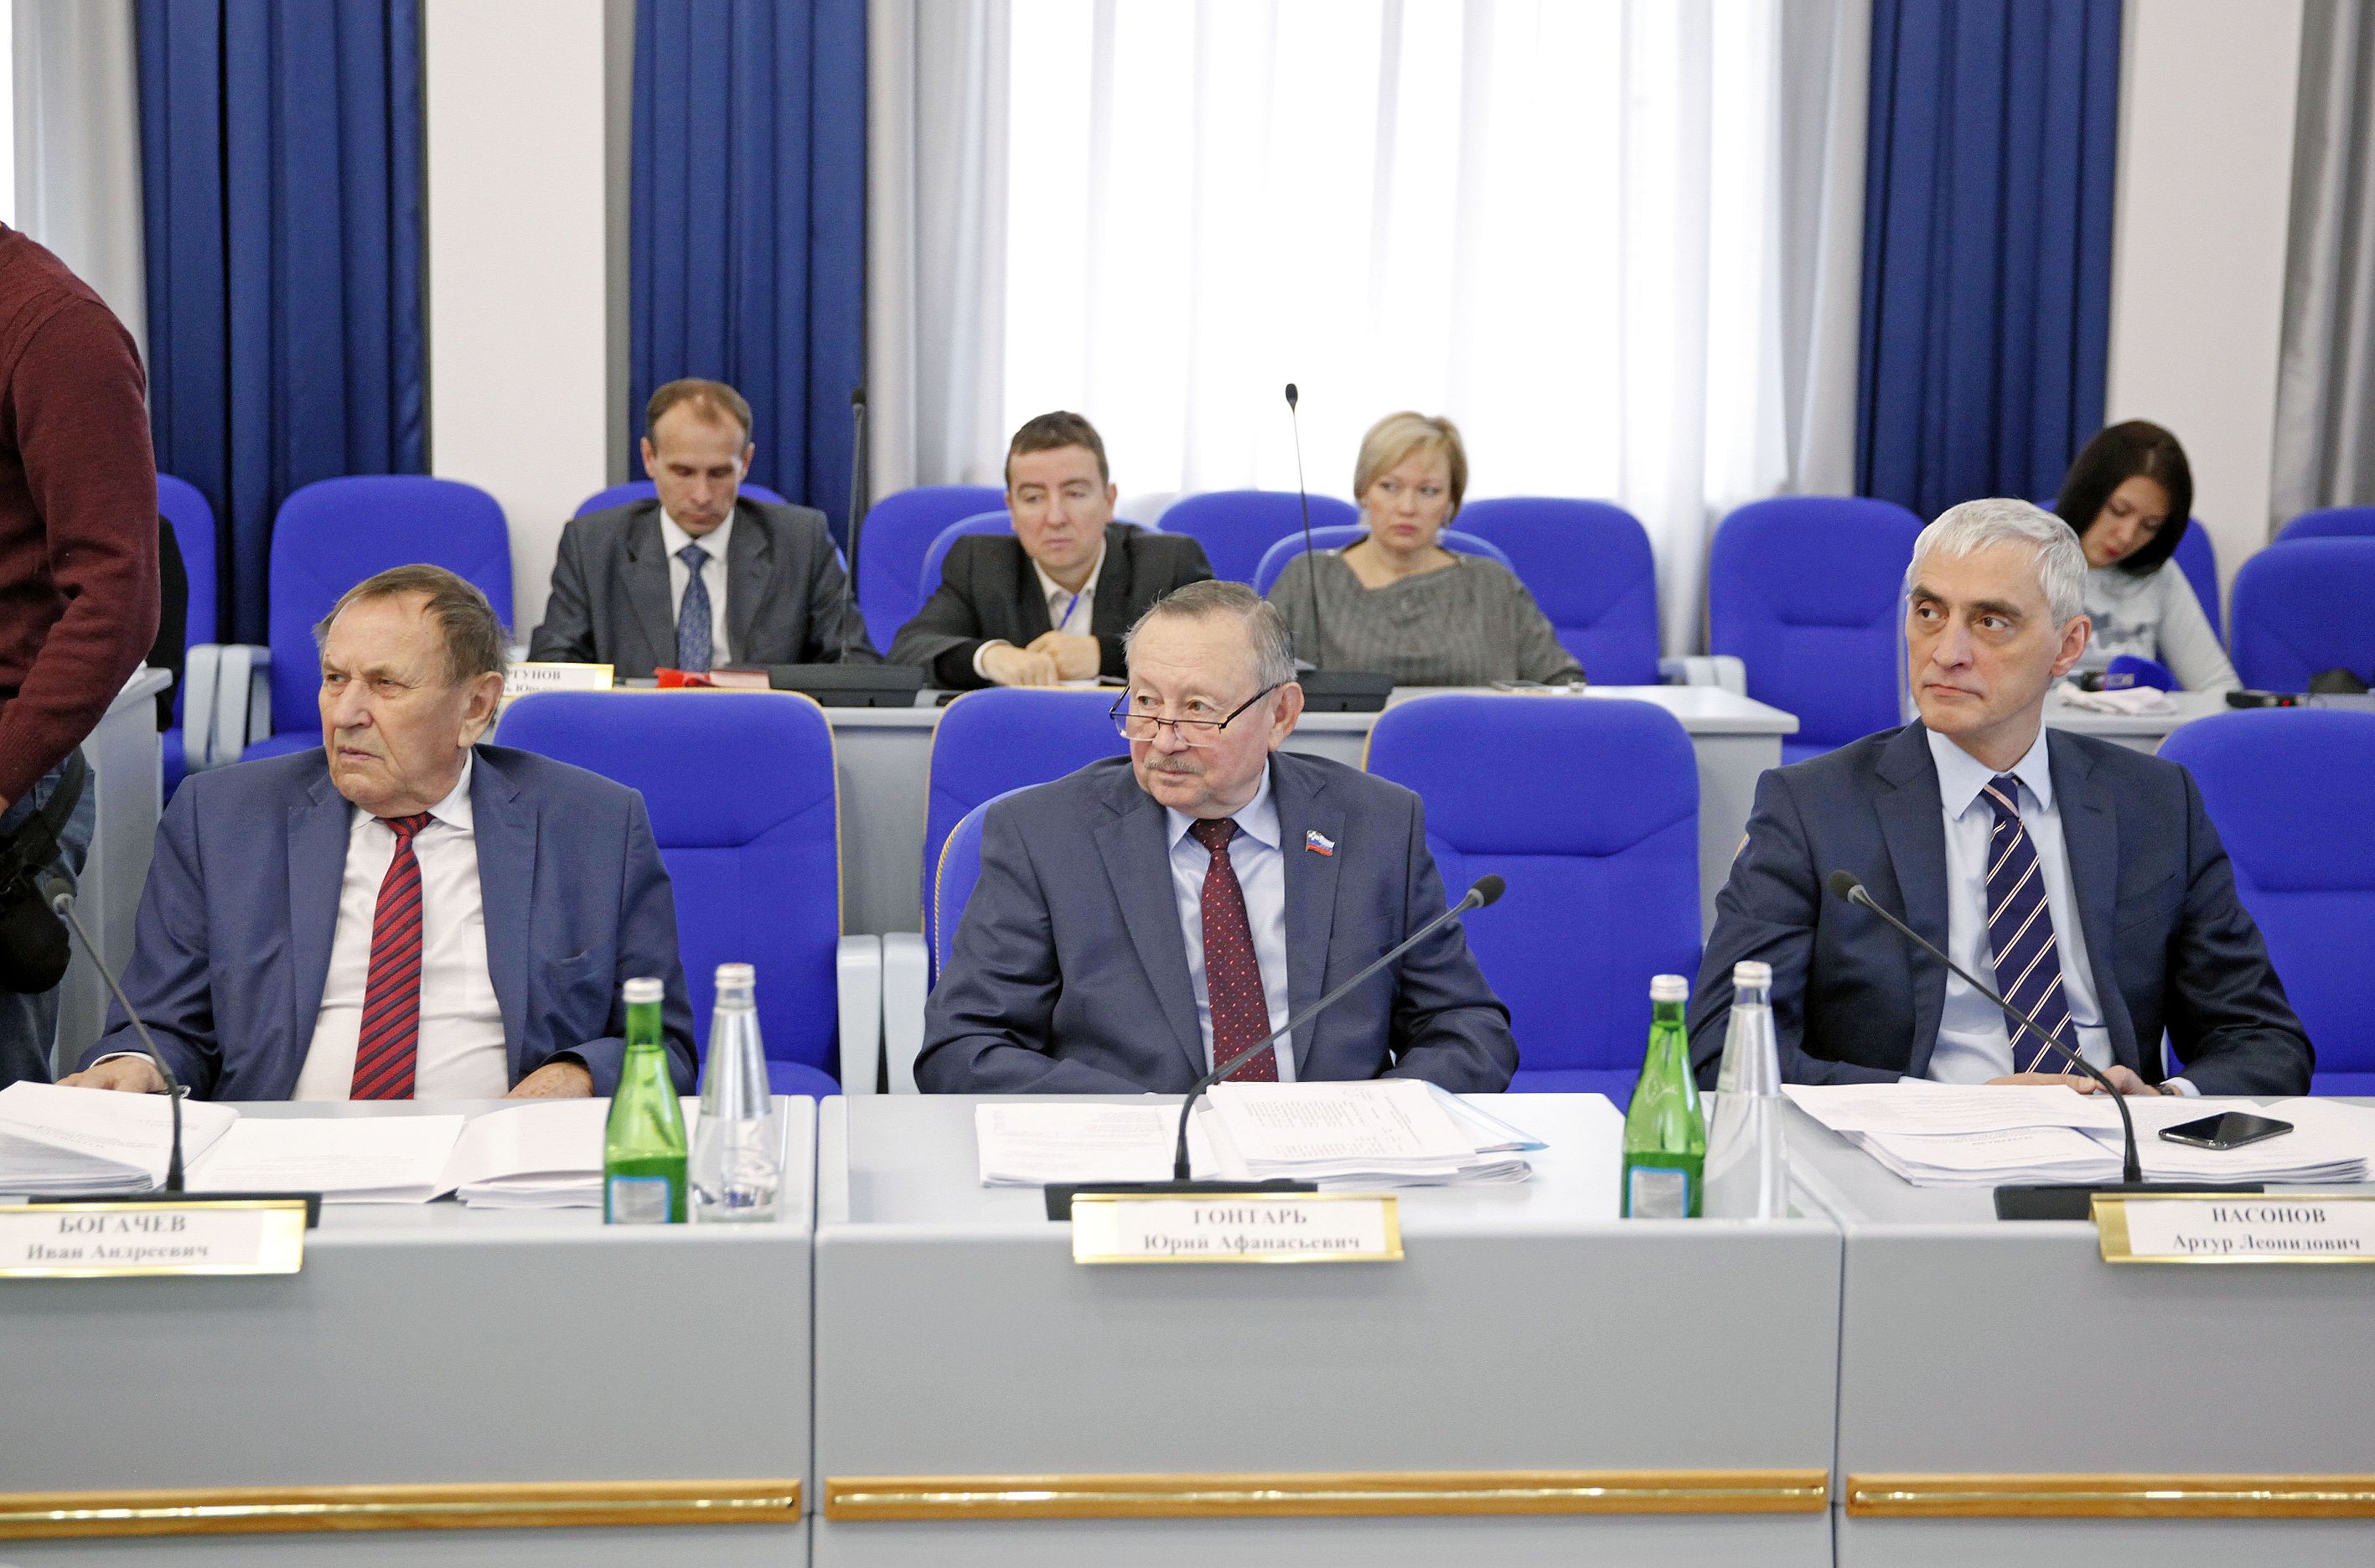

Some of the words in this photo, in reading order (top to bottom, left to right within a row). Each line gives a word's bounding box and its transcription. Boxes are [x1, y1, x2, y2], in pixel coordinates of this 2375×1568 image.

[59, 1214, 186, 1234] БОГАЧЕВ
[1193, 1208, 1307, 1224] ГОНТАРЬ
[2212, 1208, 2326, 1223] НАСОНОВ
[26, 1244, 83, 1260] Иван
[91, 1242, 208, 1261] Андреевич
[1144, 1234, 1209, 1255] Юрий
[1218, 1234, 1361, 1255] Афанасьевич
[2173, 1234, 2233, 1252] Артур
[2240, 1234, 2361, 1250] Леонидович
